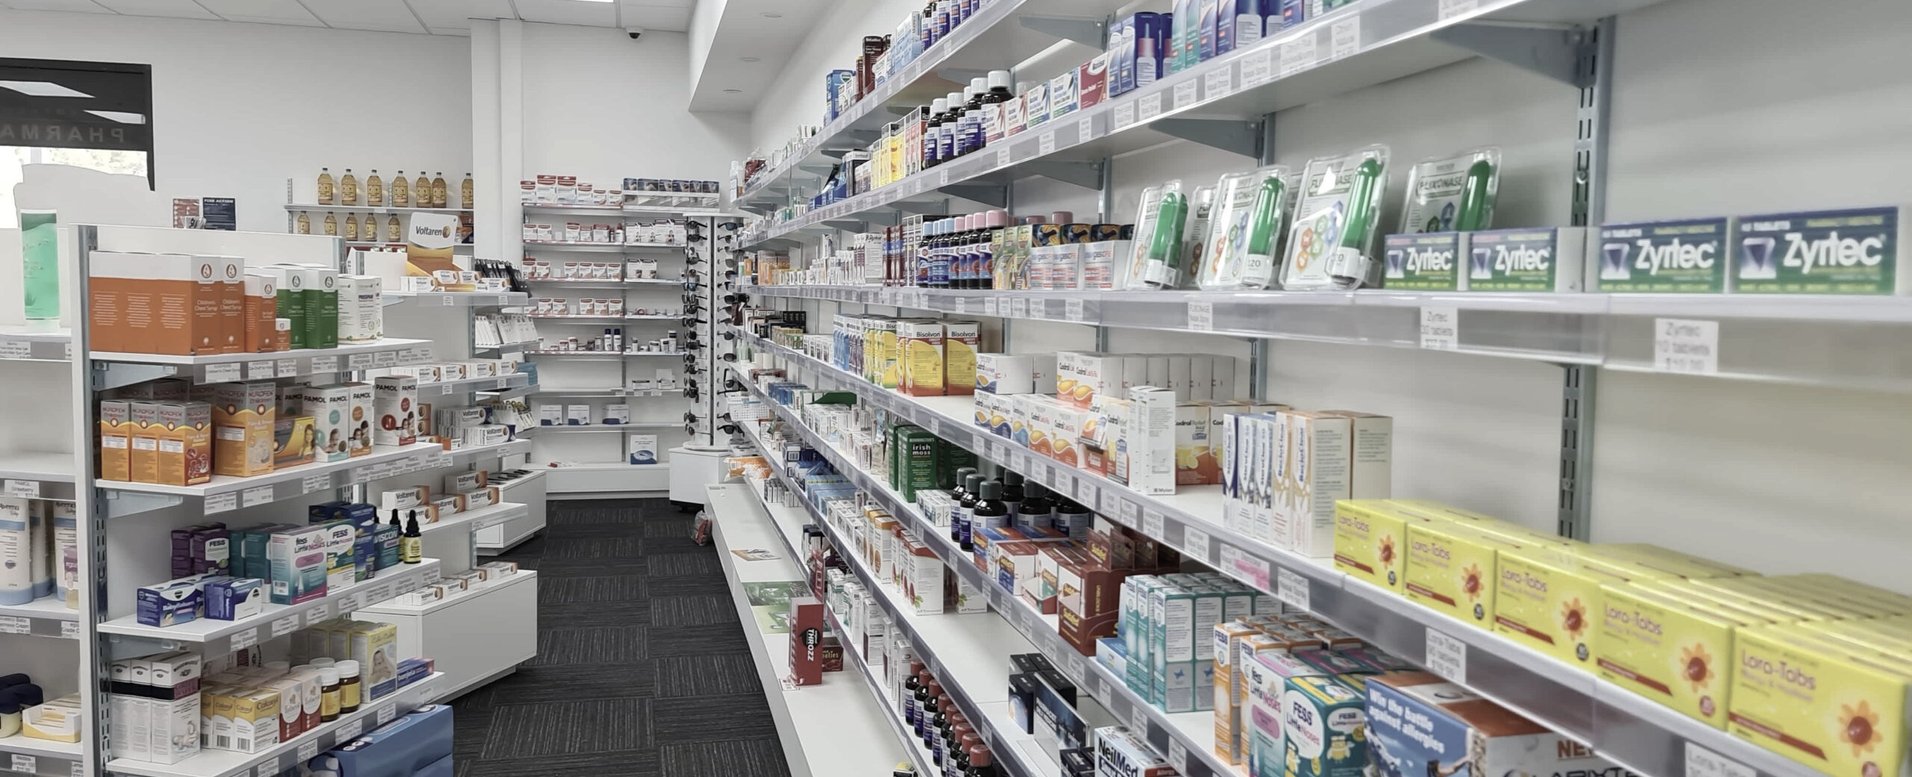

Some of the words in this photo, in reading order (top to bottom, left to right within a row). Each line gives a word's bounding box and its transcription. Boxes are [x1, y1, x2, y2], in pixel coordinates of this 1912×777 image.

[416, 225, 442, 236] Voltaren
[1407, 247, 1452, 275] Zyrtec
[1494, 244, 1550, 276] Zyrtec
[1635, 237, 1715, 275] Zyrtec
[1783, 231, 1883, 274] Zyrtec
[1665, 321, 1701, 337] Zyrtec
[304, 395, 326, 403] PAMOL
[375, 384, 398, 392] PAMOL
[332, 529, 348, 539] FESS
[1604, 603, 1663, 636] Lora-Tabs
[807, 628, 815, 662] THROZZ
[1214, 630, 1228, 645] FESS
[1251, 666, 1262, 684] fess
[1743, 648, 1816, 690] Lora-Tabs
[1293, 702, 1313, 726] FESS
[1369, 688, 1387, 708] Win
[1388, 698, 1403, 717] the
[1404, 706, 1433, 732] battle
[1369, 705, 1401, 731] against
[1402, 723, 1445, 754] allergies
[1098, 736, 1138, 777] NeilMed
